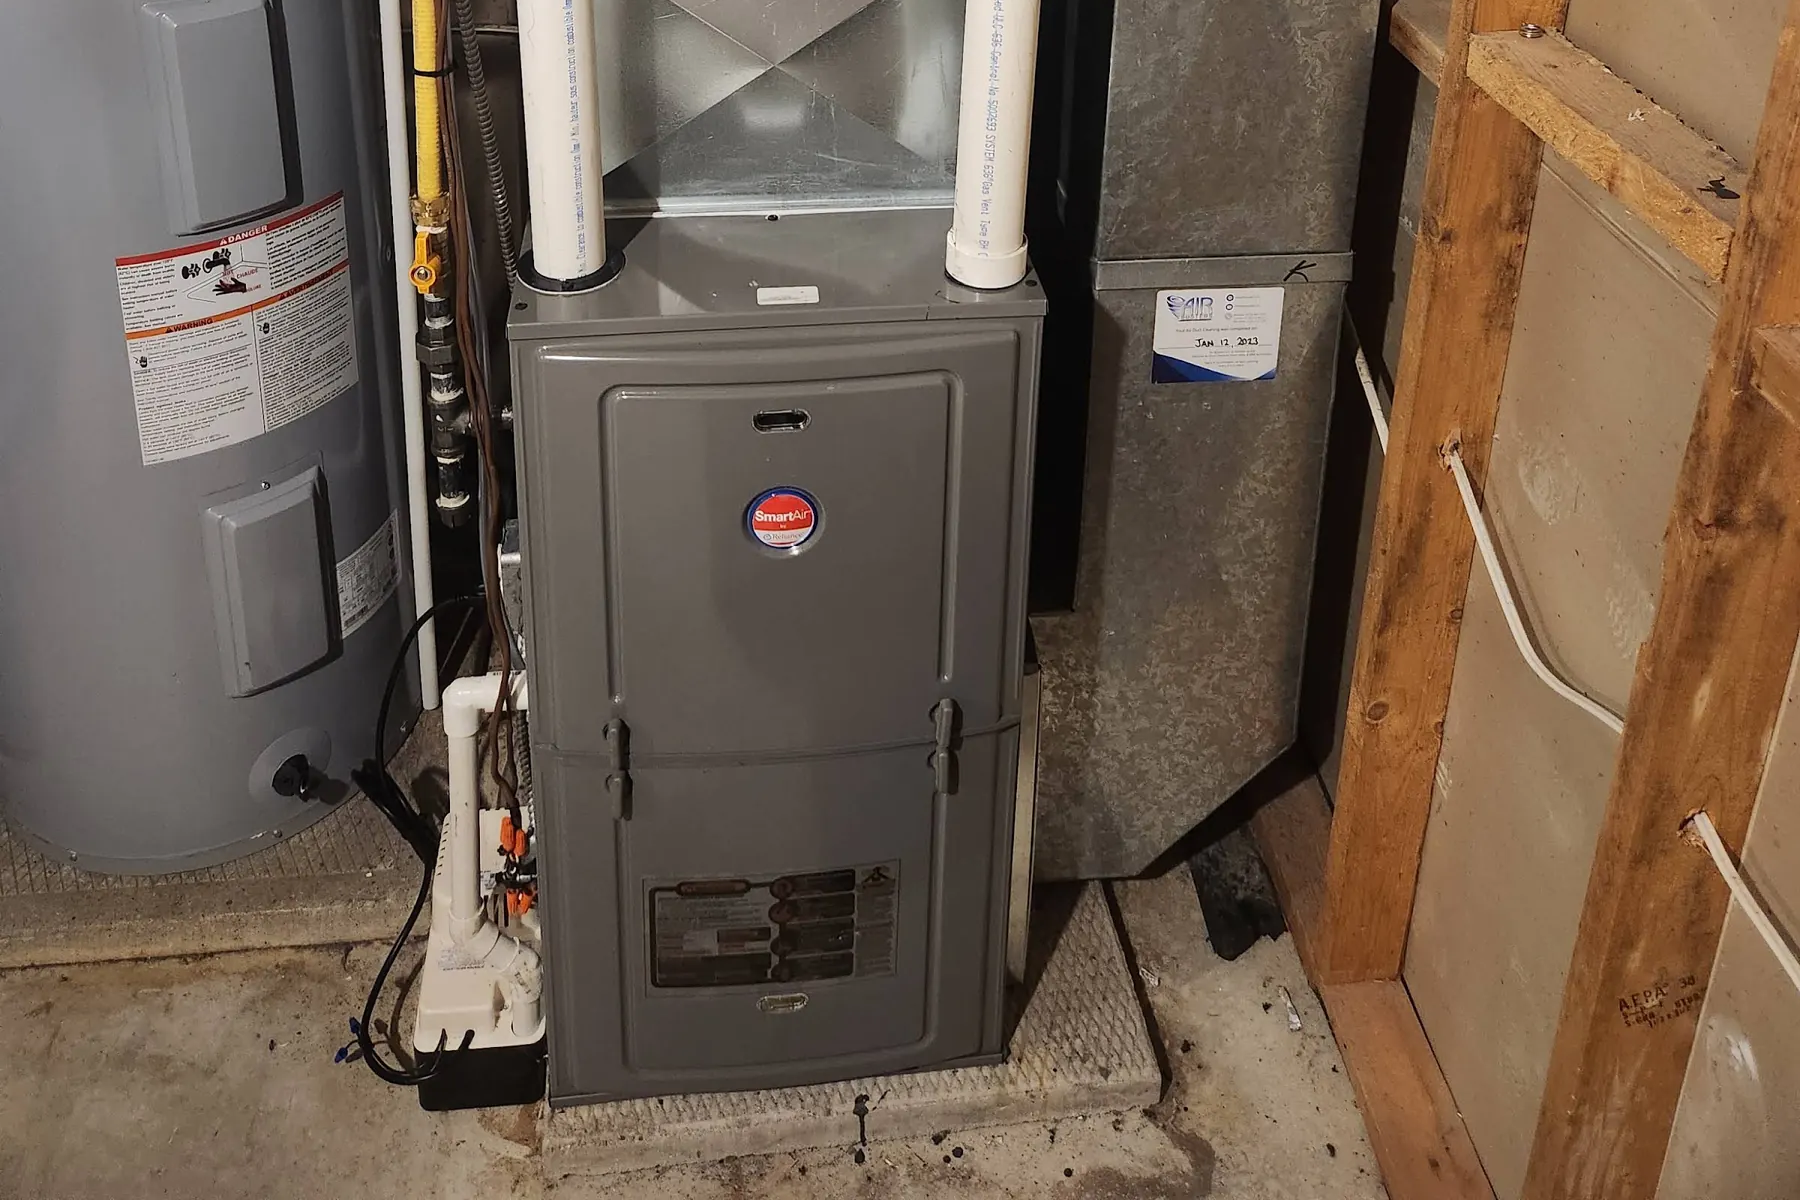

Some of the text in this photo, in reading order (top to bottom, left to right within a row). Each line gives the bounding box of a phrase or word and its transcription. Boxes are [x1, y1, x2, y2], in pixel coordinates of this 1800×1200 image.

[564, 11, 575, 45] combustible
[992, 14, 1004, 30] ULC
[991, 32, 1002, 48] 636
[565, 47, 576, 84] construction
[989, 50, 1001, 82] Control
[989, 85, 999, 96] No
[984, 135, 996, 161] SYSTEM
[573, 155, 582, 190] construction
[574, 191, 584, 223] combustible
[981, 199, 992, 215] Vent
[227, 224, 269, 243] DANGER
[979, 221, 990, 236] Type
[979, 240, 989, 249] BH
[1183, 296, 1214, 318] AIR
[173, 318, 214, 332] WARNING
[1195, 337, 1215, 348] JAN
[1237, 336, 1259, 346] 2023
[754, 510, 811, 523] SmartAir
